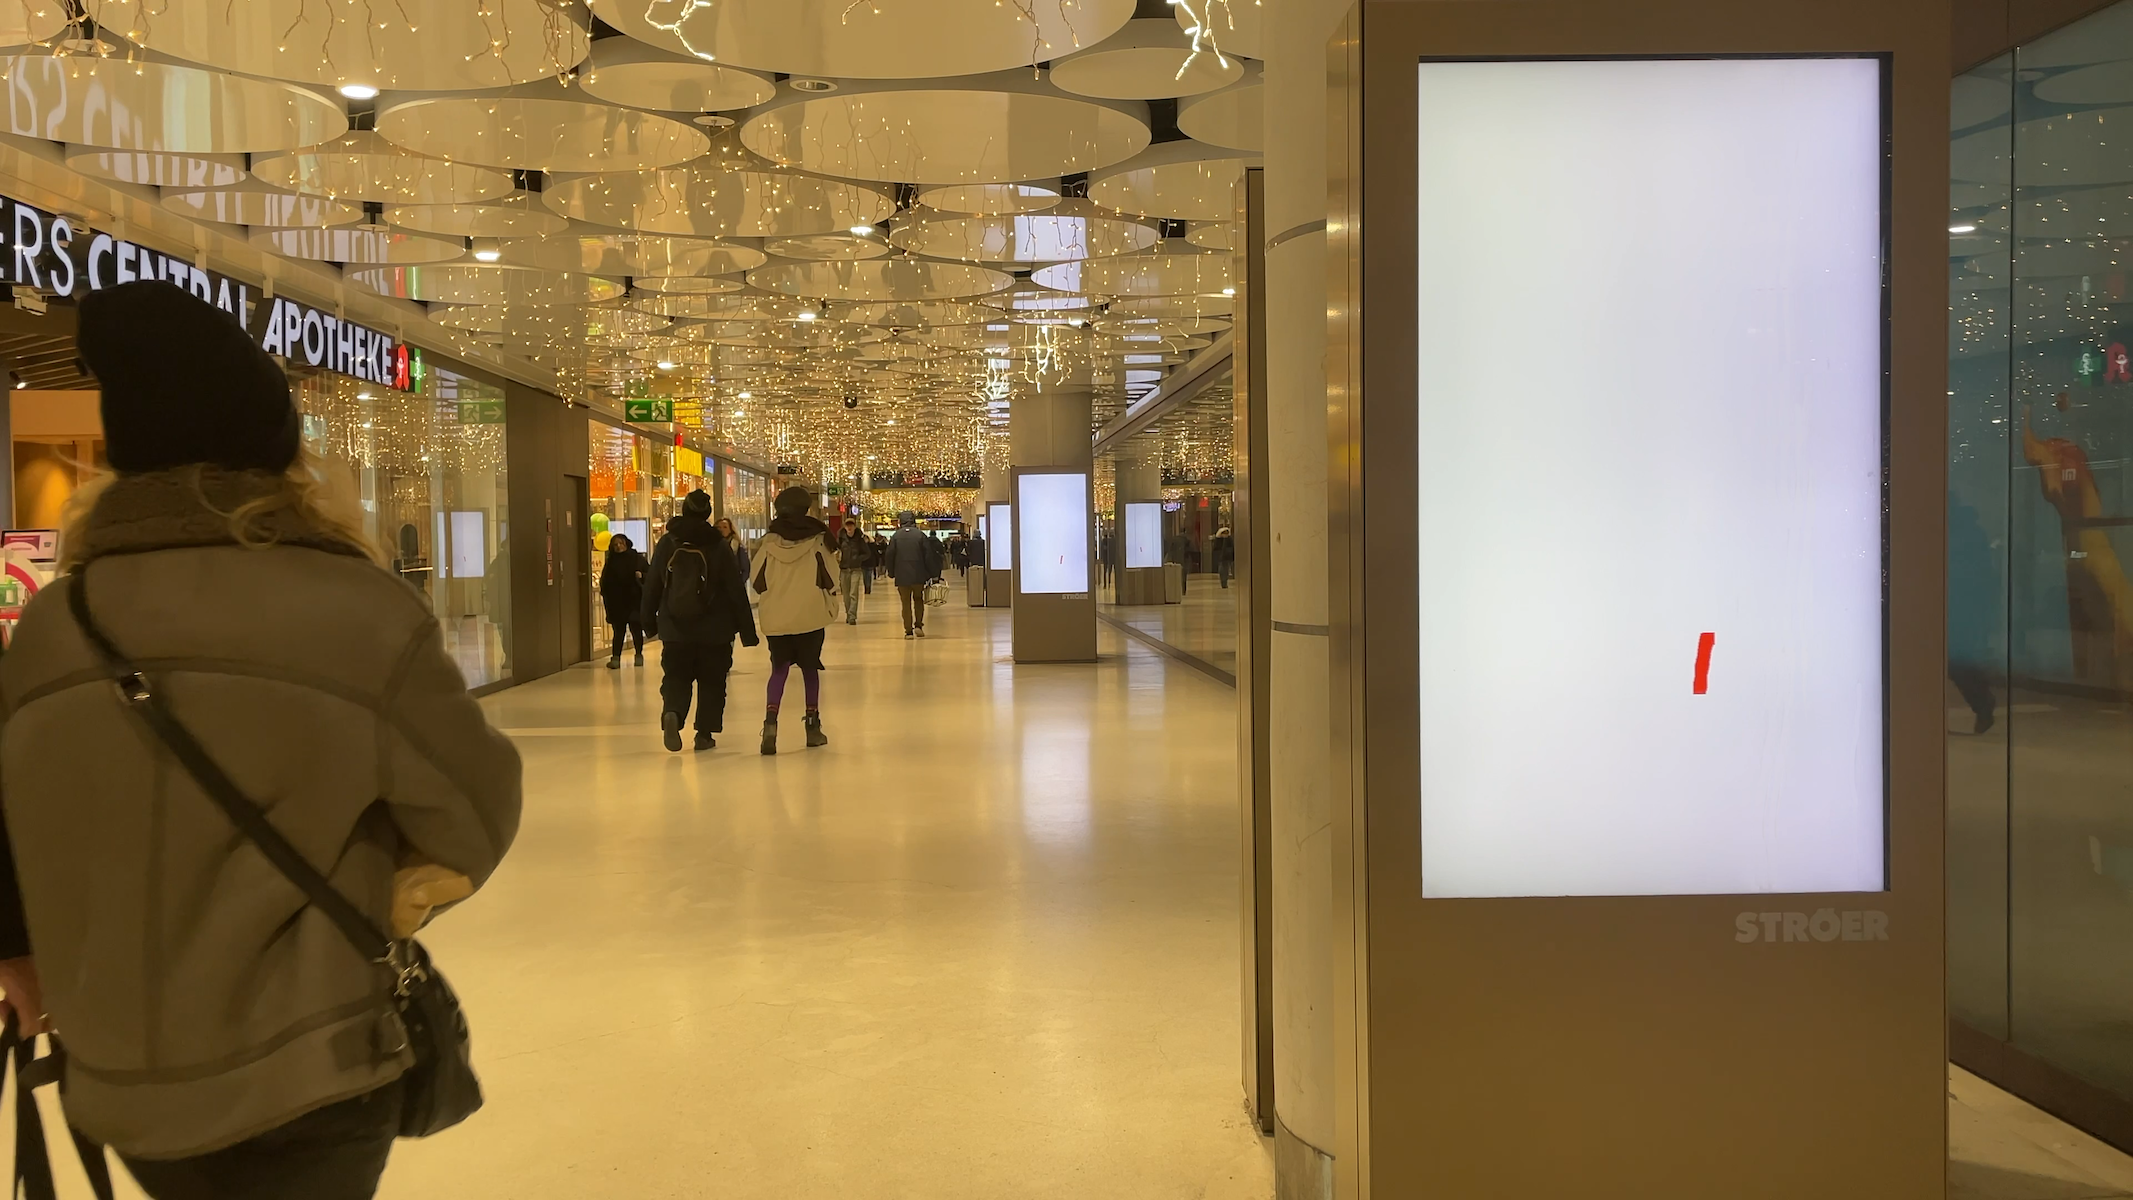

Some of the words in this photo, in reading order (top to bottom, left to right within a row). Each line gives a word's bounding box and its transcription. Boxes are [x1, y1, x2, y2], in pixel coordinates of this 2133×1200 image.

[0, 198, 75, 297] RS
[262, 297, 393, 386] APOTHEKE
[1735, 908, 1889, 943] STRÖER
